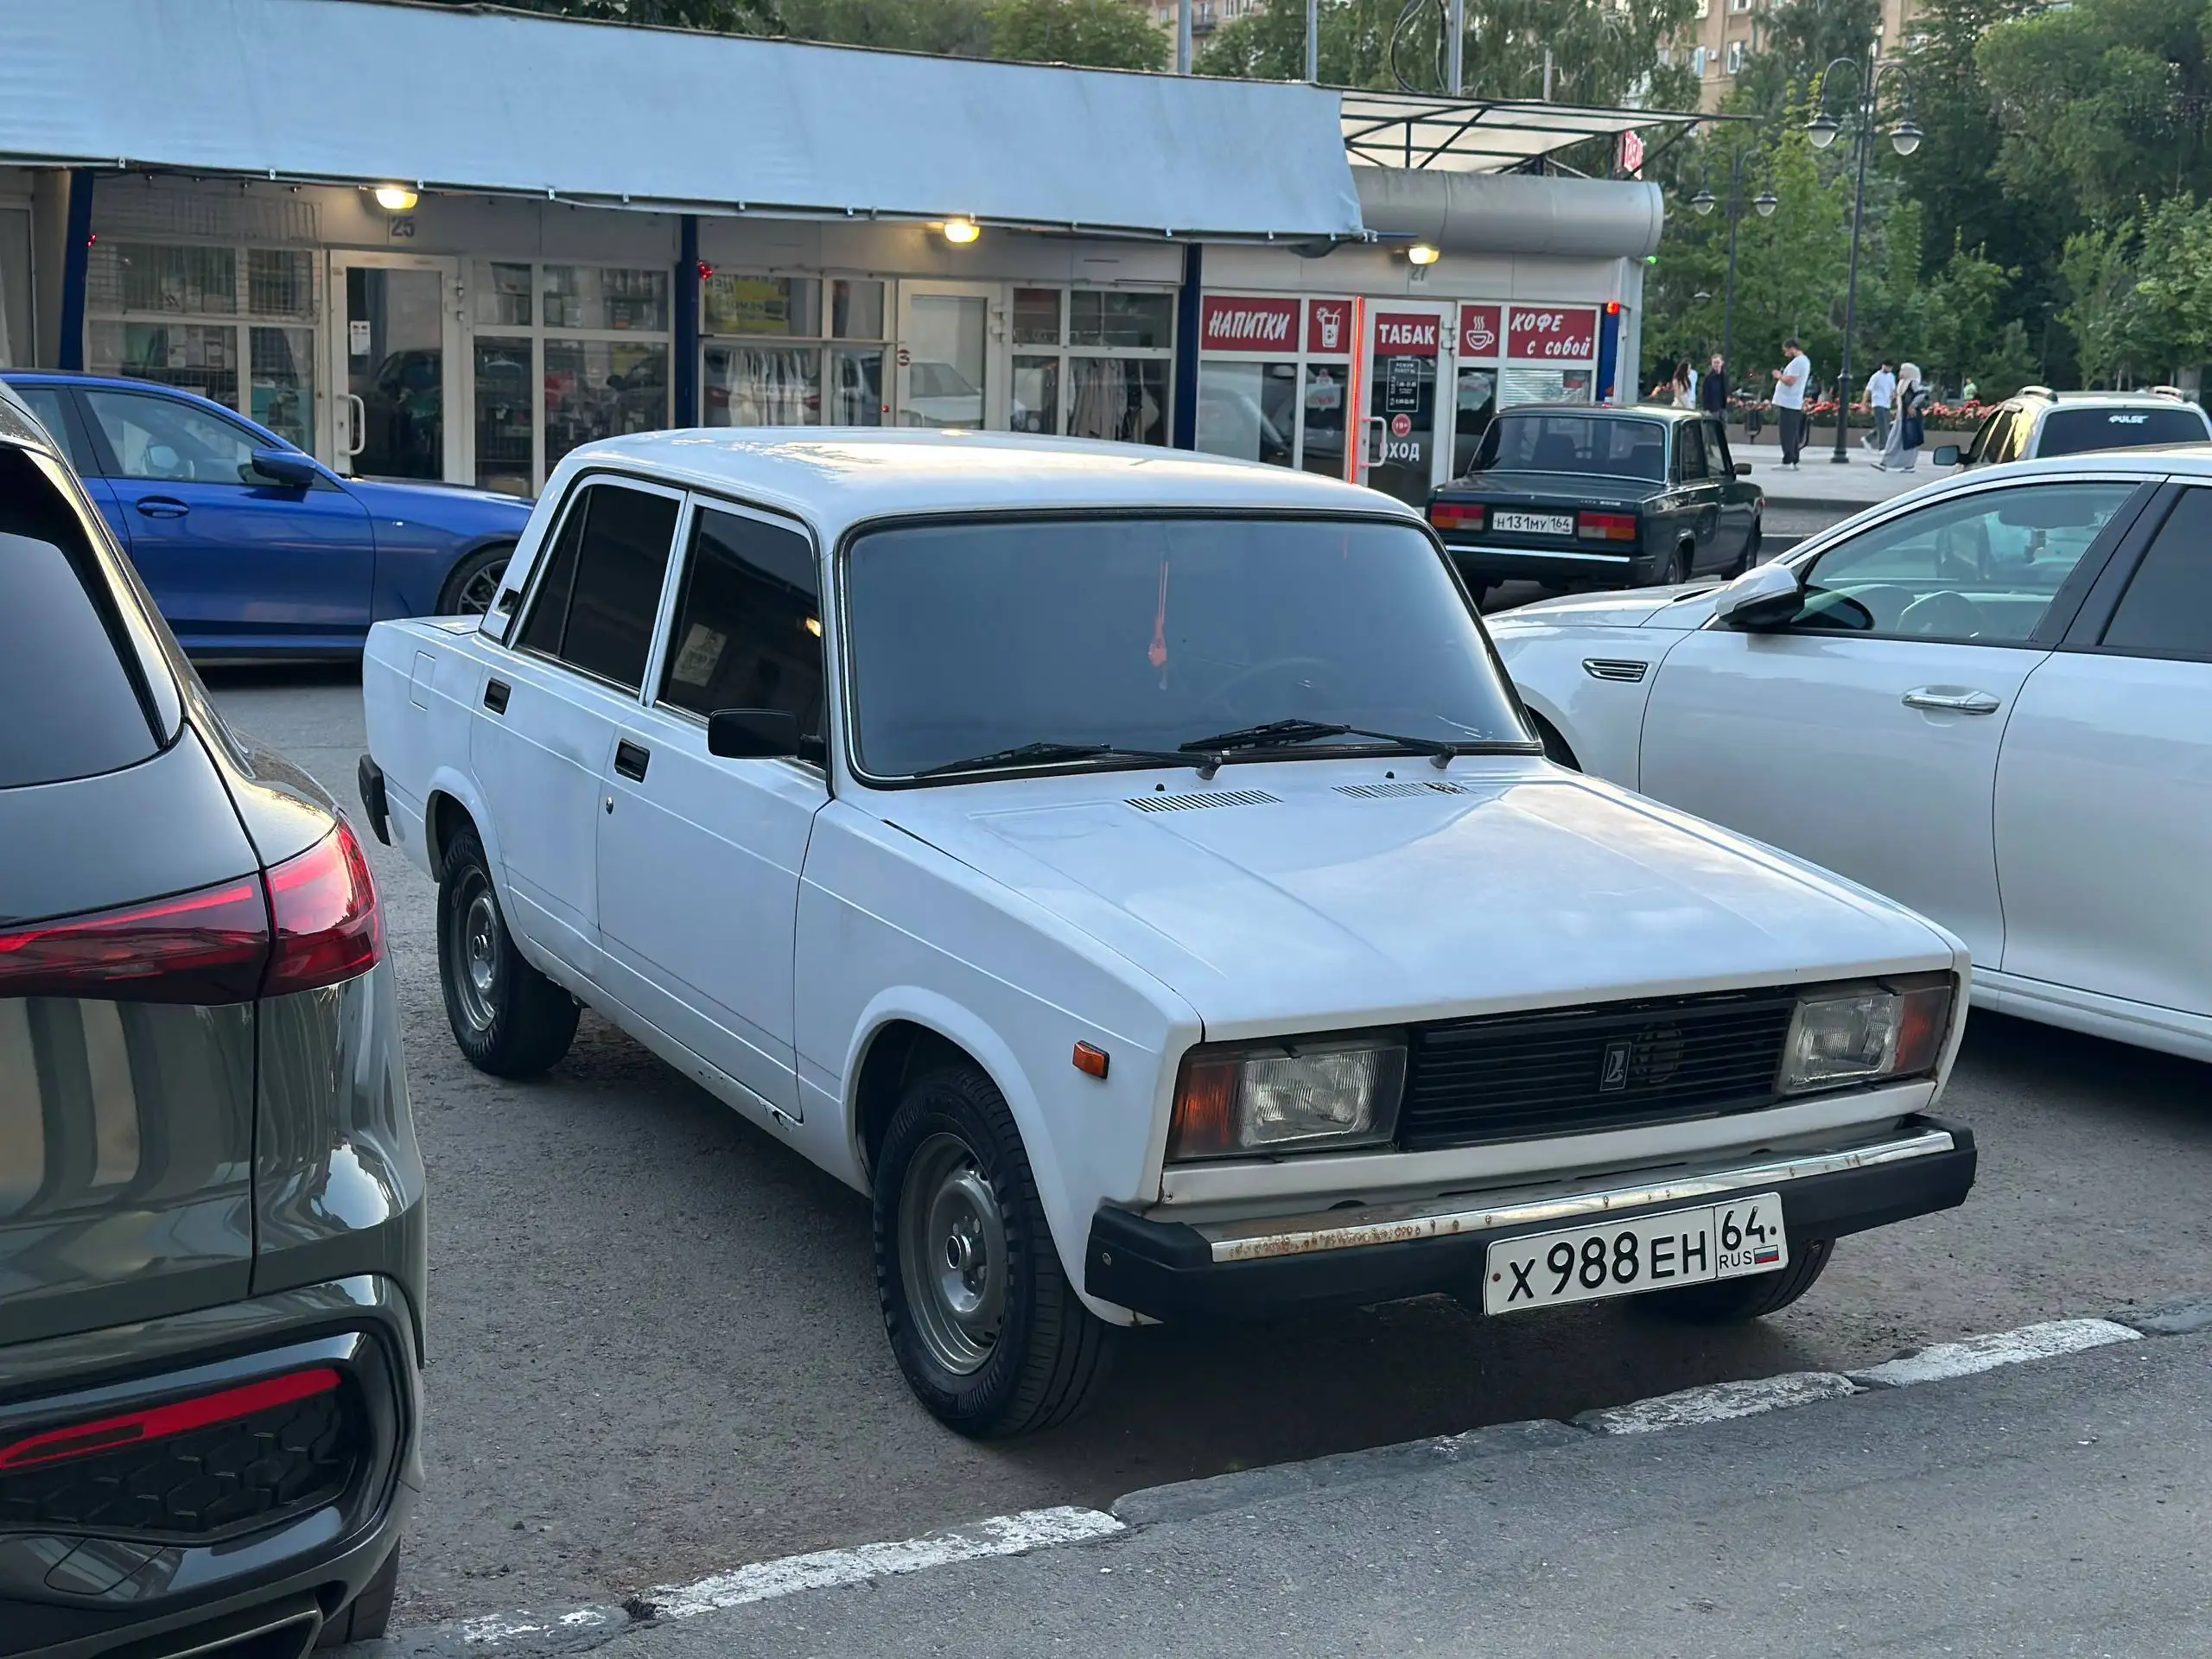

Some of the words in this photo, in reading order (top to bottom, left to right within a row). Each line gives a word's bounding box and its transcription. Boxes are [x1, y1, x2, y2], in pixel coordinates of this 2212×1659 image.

[391, 216, 416, 238] 25
[1208, 309, 1291, 341] НАПИТКИ
[1379, 323, 1435, 345] ТАБАК
[1510, 313, 1564, 333] КОФЕ
[1527, 340, 1536, 355] с
[1545, 335, 1592, 357] собой
[1551, 518, 1570, 529] 164
[1721, 1205, 1766, 1251] 64
[1719, 1249, 1753, 1269] RUS
